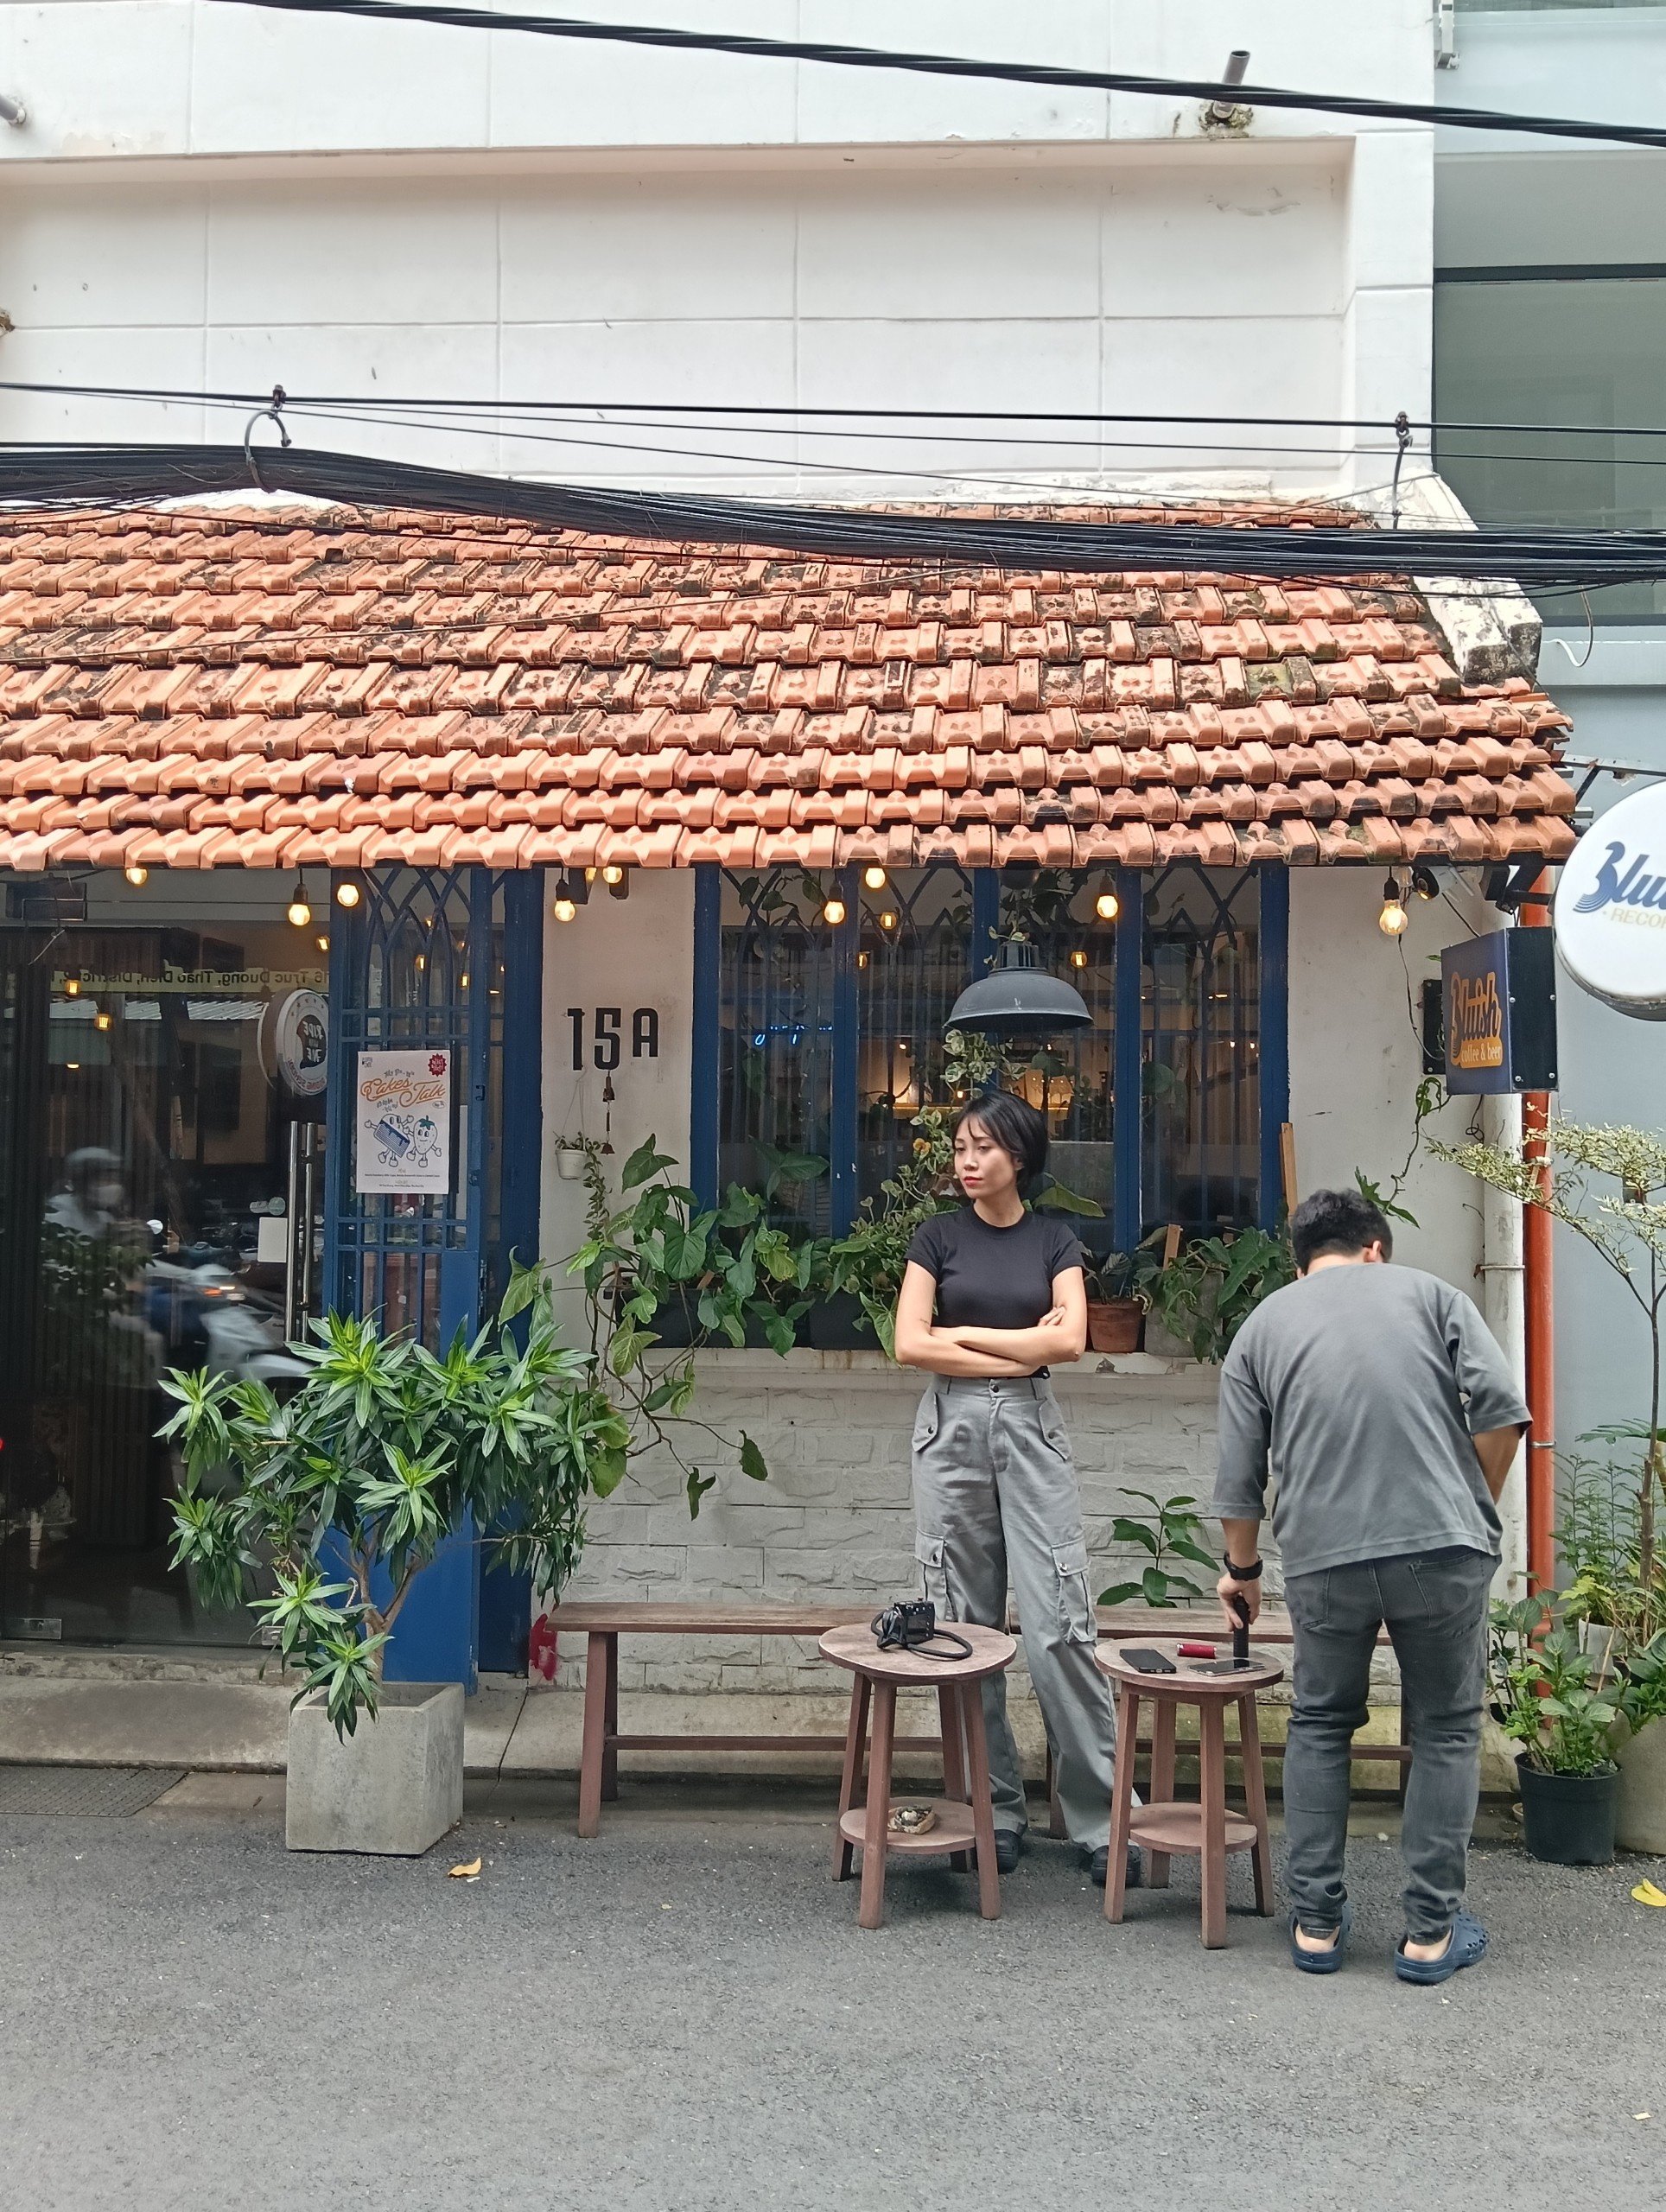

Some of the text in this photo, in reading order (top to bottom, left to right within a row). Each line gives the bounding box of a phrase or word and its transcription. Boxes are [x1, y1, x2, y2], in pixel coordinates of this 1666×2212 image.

[567, 1007, 658, 1071] 15A
[1460, 1042, 1502, 1063] coffee & beer
[360, 1077, 413, 1102] Cakes
[399, 1080, 447, 1108] Talk
